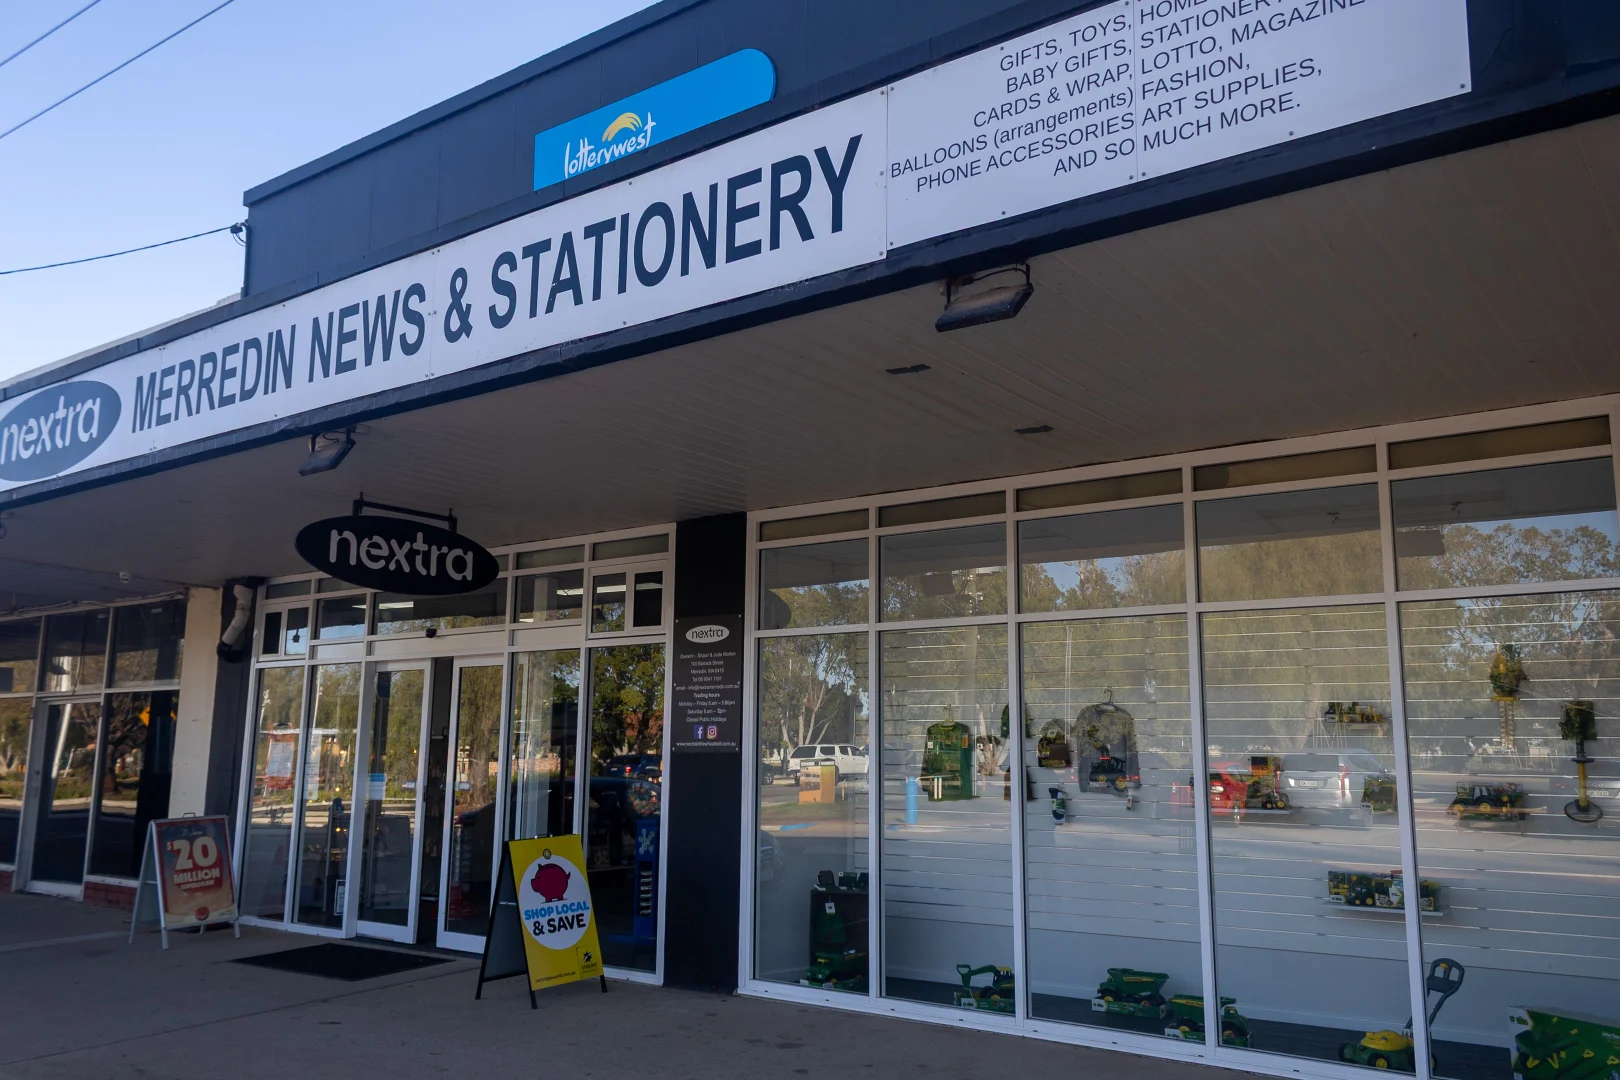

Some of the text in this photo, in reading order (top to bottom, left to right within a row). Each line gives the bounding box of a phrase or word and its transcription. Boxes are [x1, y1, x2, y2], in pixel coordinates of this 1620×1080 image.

[1000, 38, 1063, 72] GIFTS,
[1069, 14, 1132, 47] TOYS,
[1006, 0, 1283, 94] BABY GIFTS, STATIONER
[891, 52, 1250, 178] BALLOONS (arrangements) FASHION,
[973, 93, 1041, 128] CARDS
[1047, 86, 1060, 104] &
[1066, 62, 1133, 97] WRAP,
[1141, 36, 1223, 75] LOTTO,
[564, 111, 656, 179] lotterywest
[917, 57, 1322, 193] PHONE ACCESSORIES ART SUPPLIES,
[1053, 92, 1301, 176] AND SO MUCH MORE.
[131, 133, 863, 434] MERREDIN NEWS & STATIONERY
[0, 395, 101, 466] nextra
[329, 528, 474, 582] nextra
[691, 626, 724, 640] nextra
[172, 867, 220, 885] MILLION
[523, 901, 590, 921] SHOP LOCAL
[532, 913, 587, 936] & SAVE
